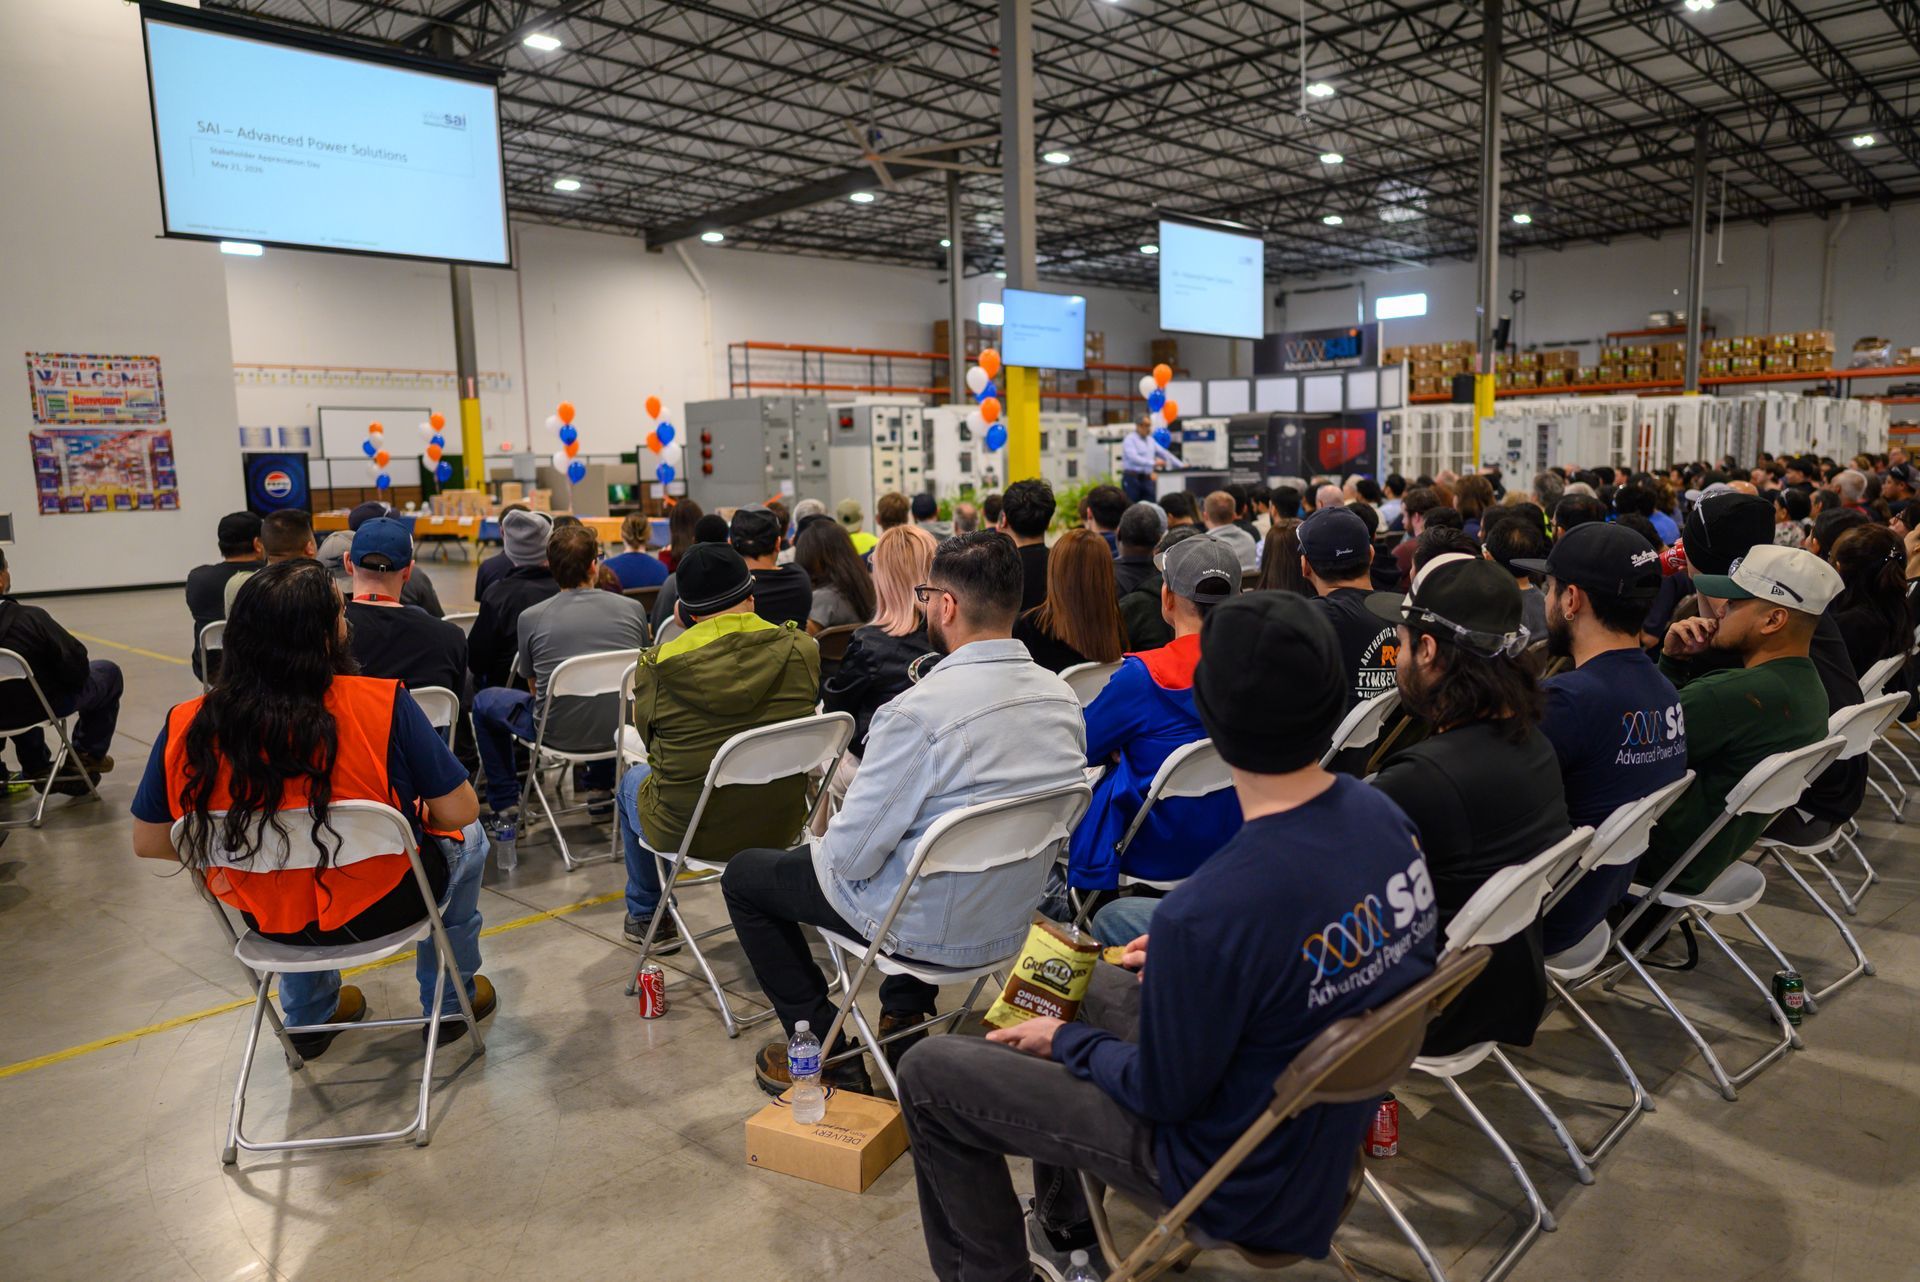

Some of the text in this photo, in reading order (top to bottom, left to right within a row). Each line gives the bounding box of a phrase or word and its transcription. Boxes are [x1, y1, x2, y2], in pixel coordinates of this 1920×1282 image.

[197, 120, 220, 135] SAI
[237, 126, 304, 148] Advanced
[307, 135, 347, 153] Power
[351, 144, 408, 163] Solutions
[211, 160, 229, 170] May
[36, 369, 156, 389] WELCOME
[1360, 626, 1392, 667] AUTHENTIC
[1614, 747, 1656, 765] Advanced
[1656, 745, 1673, 760] Power
[1385, 857, 1436, 929] sa
[1307, 950, 1385, 1009] Advanced
[1383, 932, 1412, 969] Power
[1013, 996, 1034, 1010] SEA
[1036, 1005, 1062, 1018] SALT
[1017, 989, 1063, 1015] ORIGINAL
[811, 1128, 863, 1146] DELIVERY
